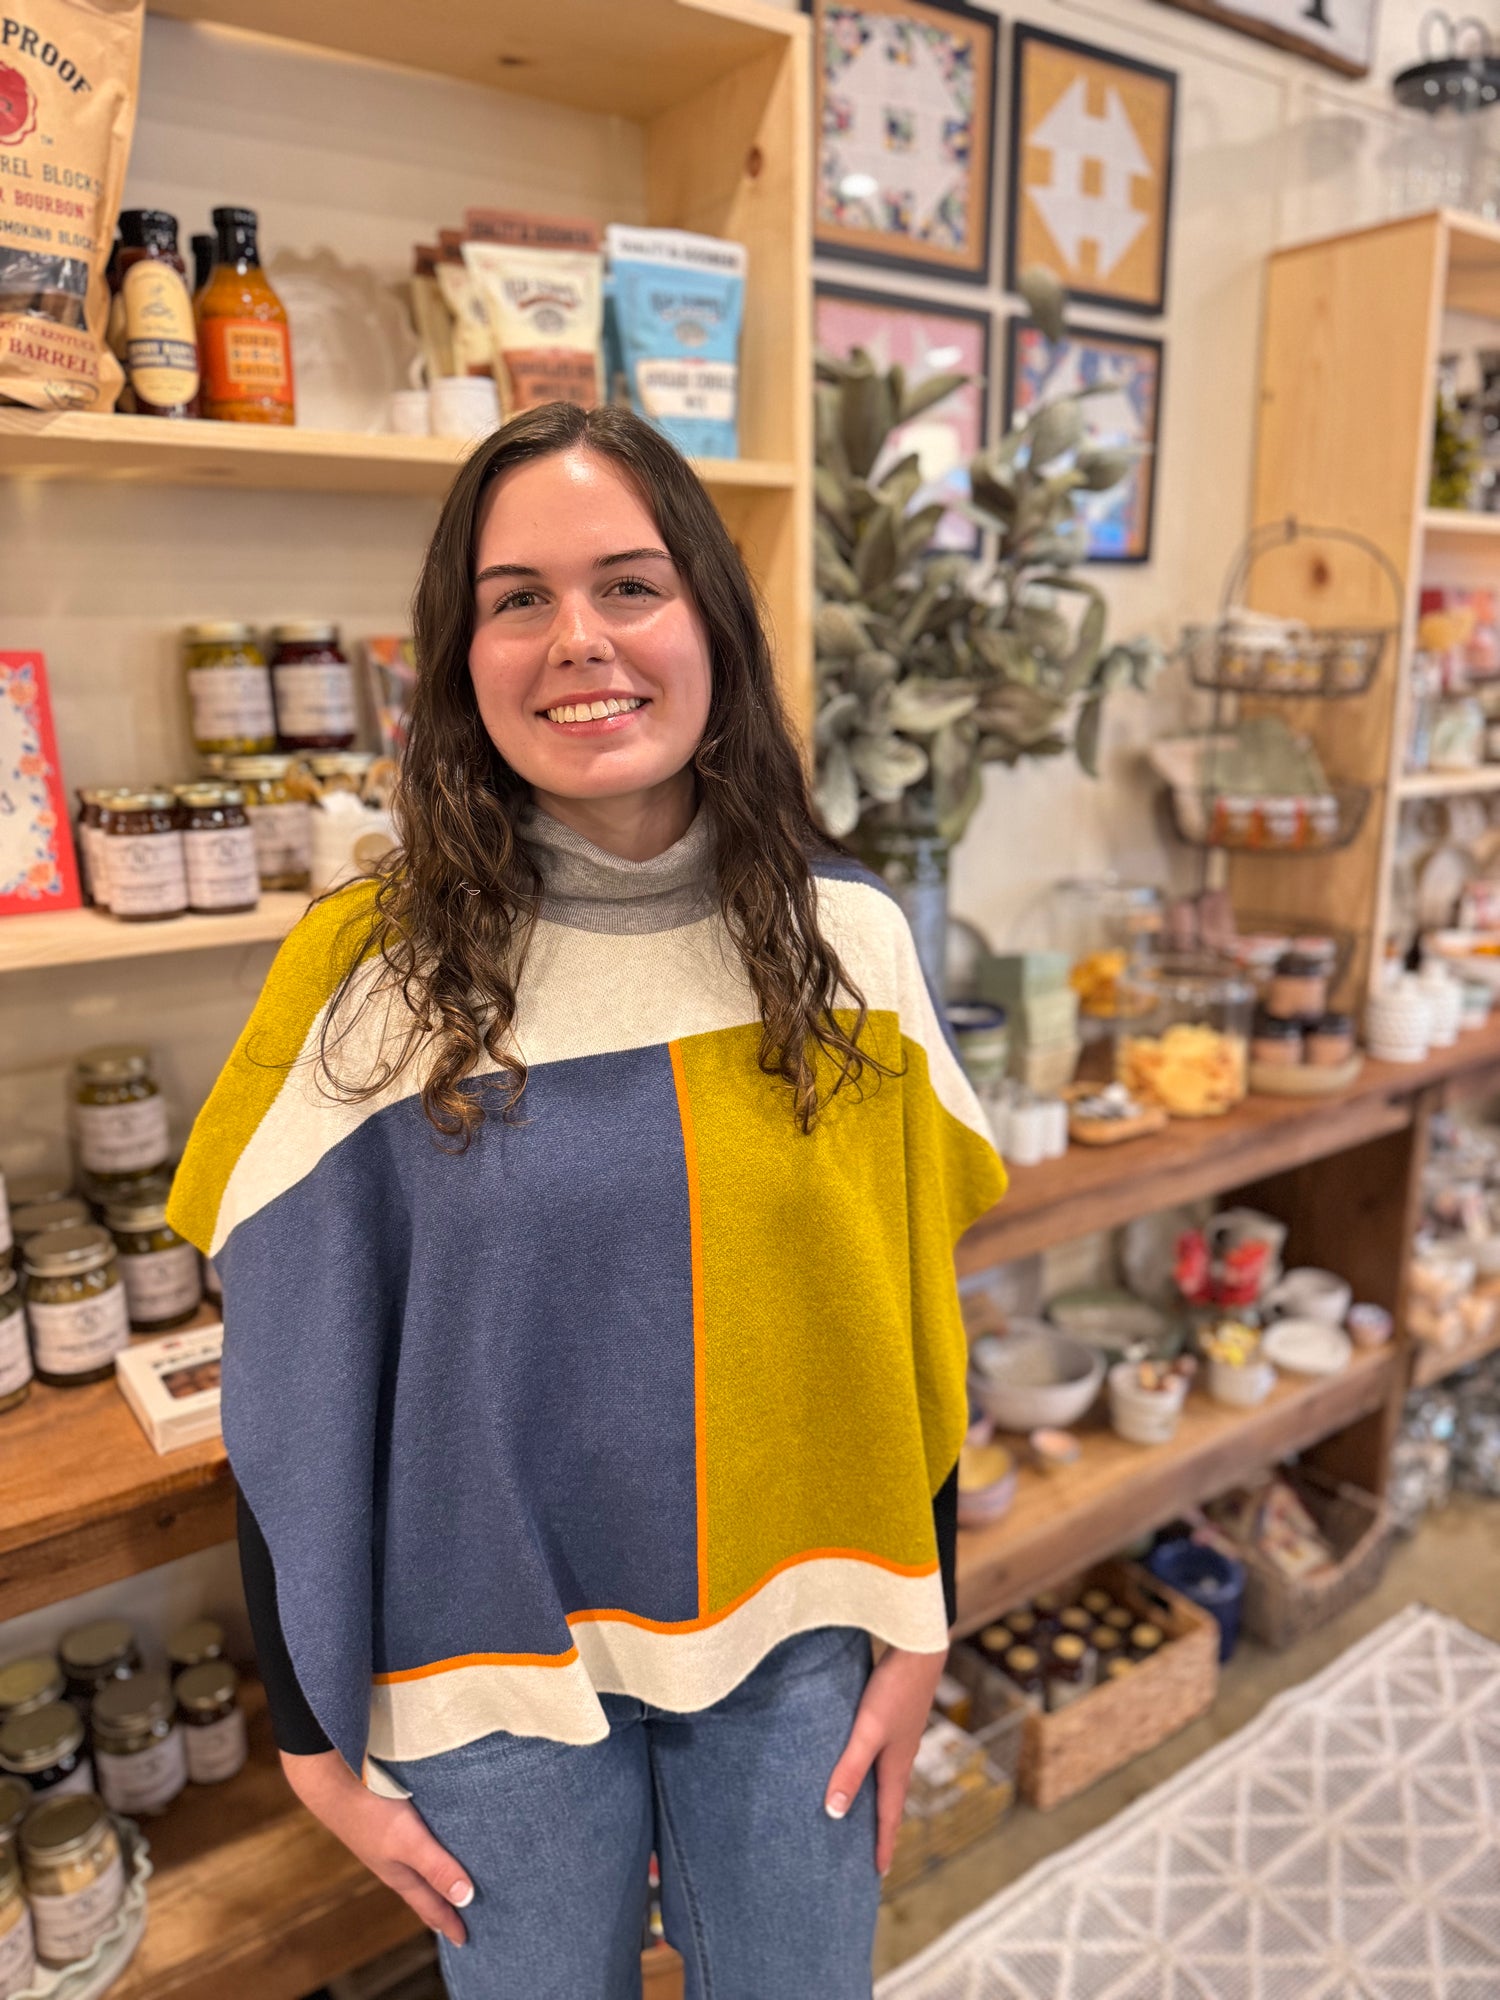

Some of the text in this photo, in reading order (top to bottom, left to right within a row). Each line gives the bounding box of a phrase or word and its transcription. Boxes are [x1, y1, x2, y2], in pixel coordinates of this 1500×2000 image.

[2, 17, 92, 94] PROOF
[15, 188, 84, 219] BOURBON
[9, 336, 99, 378] BARRELS
